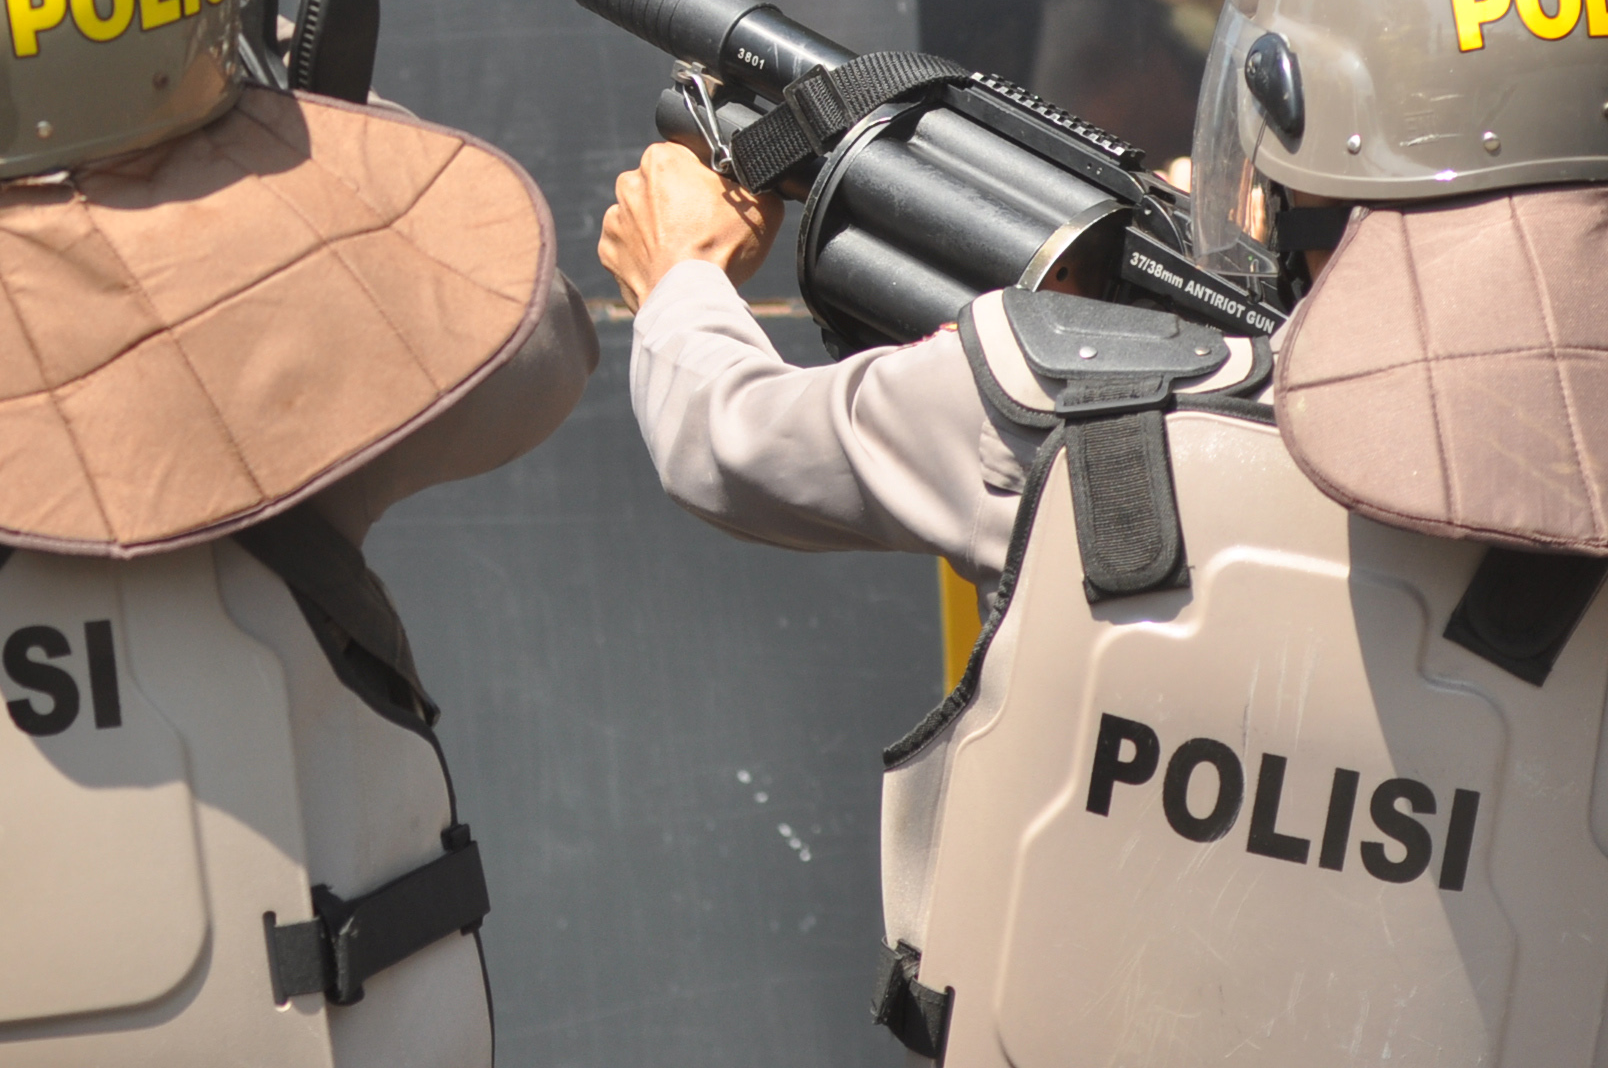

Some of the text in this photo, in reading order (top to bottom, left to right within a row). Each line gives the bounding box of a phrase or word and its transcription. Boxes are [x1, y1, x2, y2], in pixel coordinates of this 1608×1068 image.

[737, 47, 765, 70] 3801
[1129, 251, 1276, 334] 37/38mm ANTIRIOT GUN
[1085, 712, 1481, 892] POLISI
